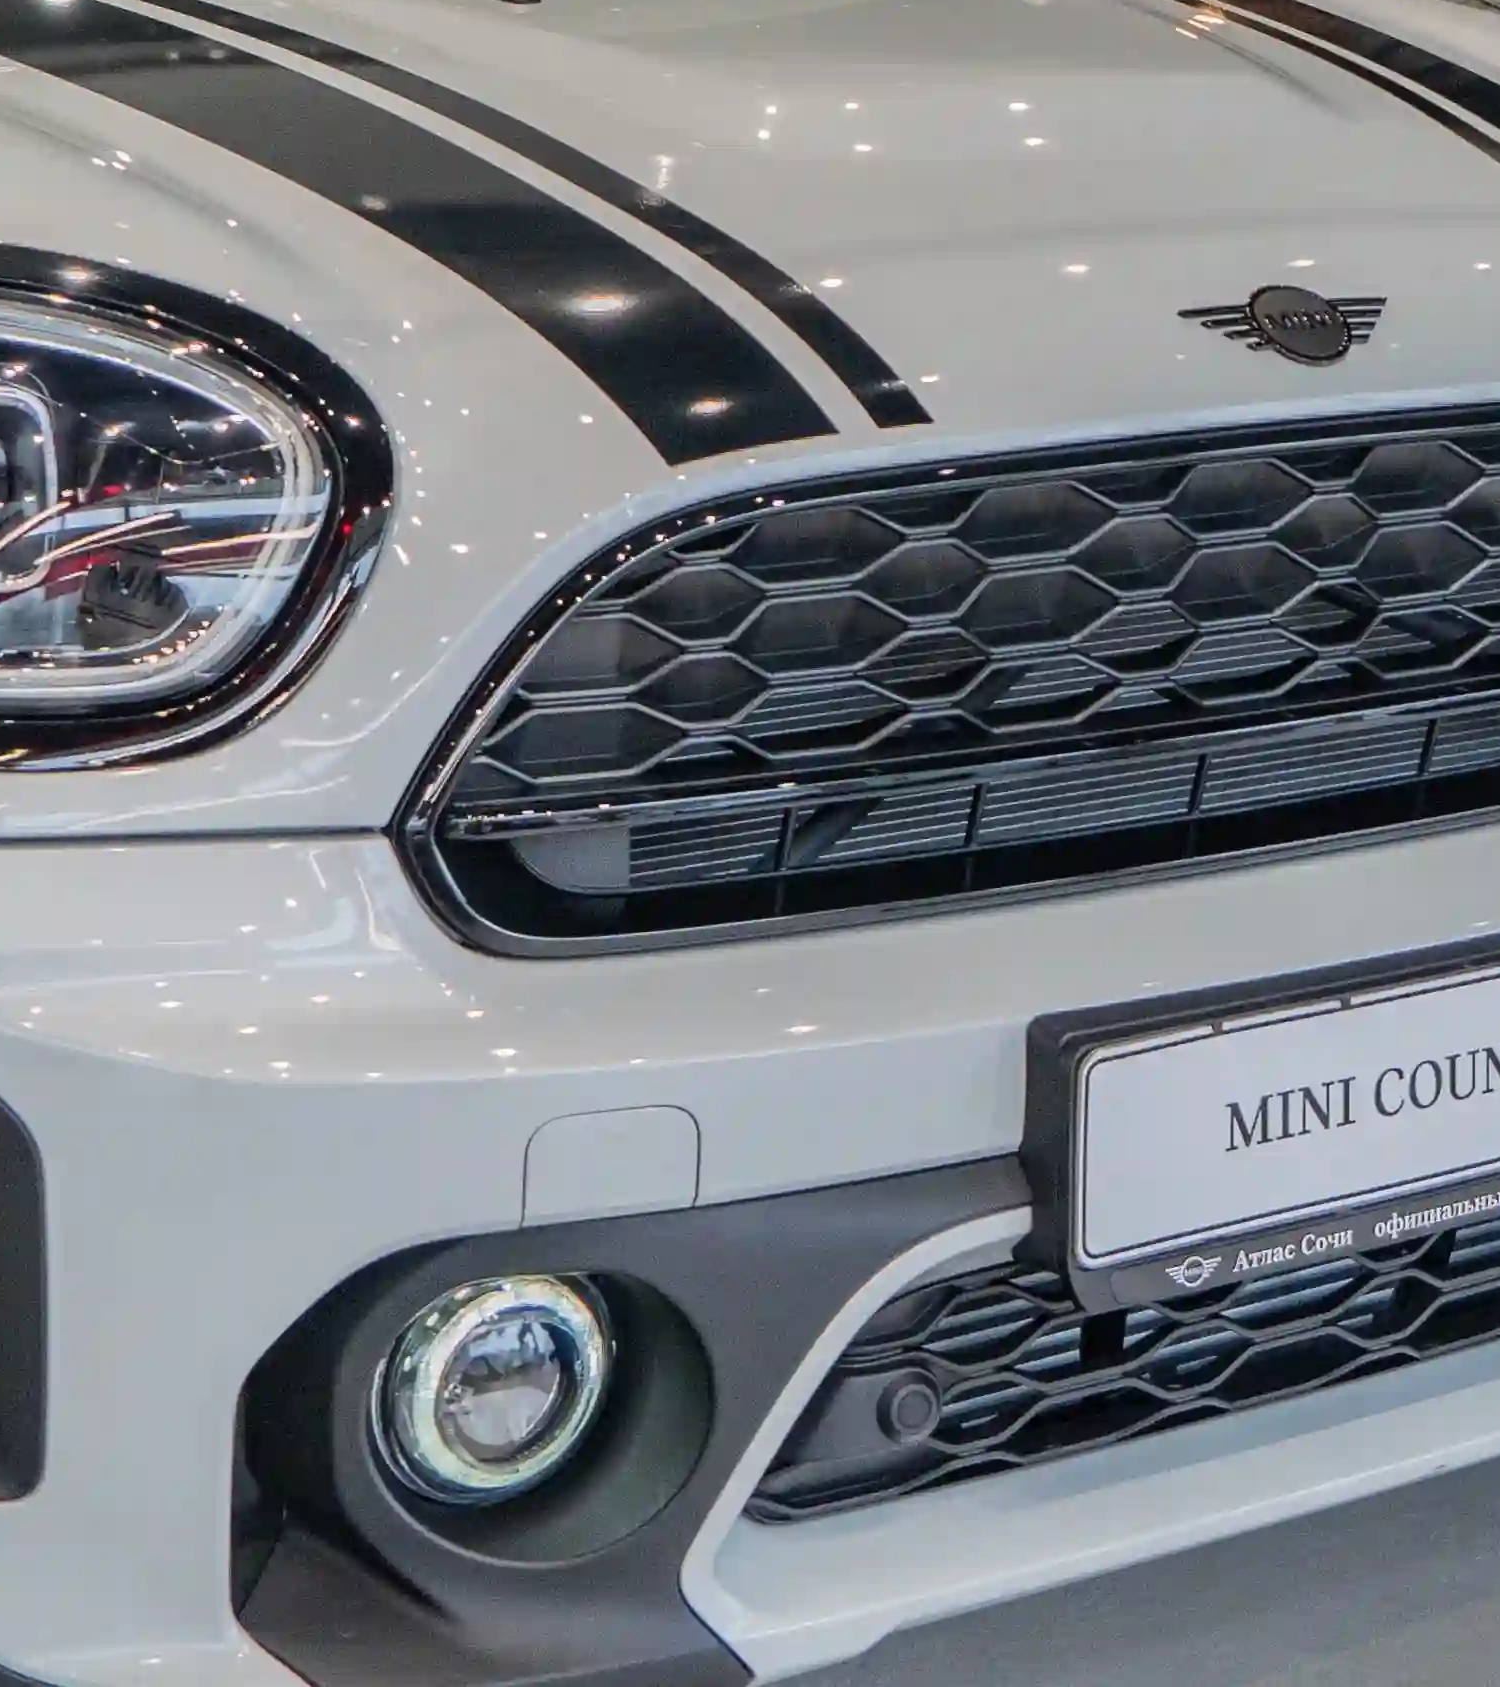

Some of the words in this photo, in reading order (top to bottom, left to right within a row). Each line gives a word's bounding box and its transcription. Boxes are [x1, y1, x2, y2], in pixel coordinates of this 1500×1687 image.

[1225, 1076, 1357, 1152] MINI
[1232, 1242, 1296, 1273] Атлас
[1301, 1228, 1353, 1256] Сочи
